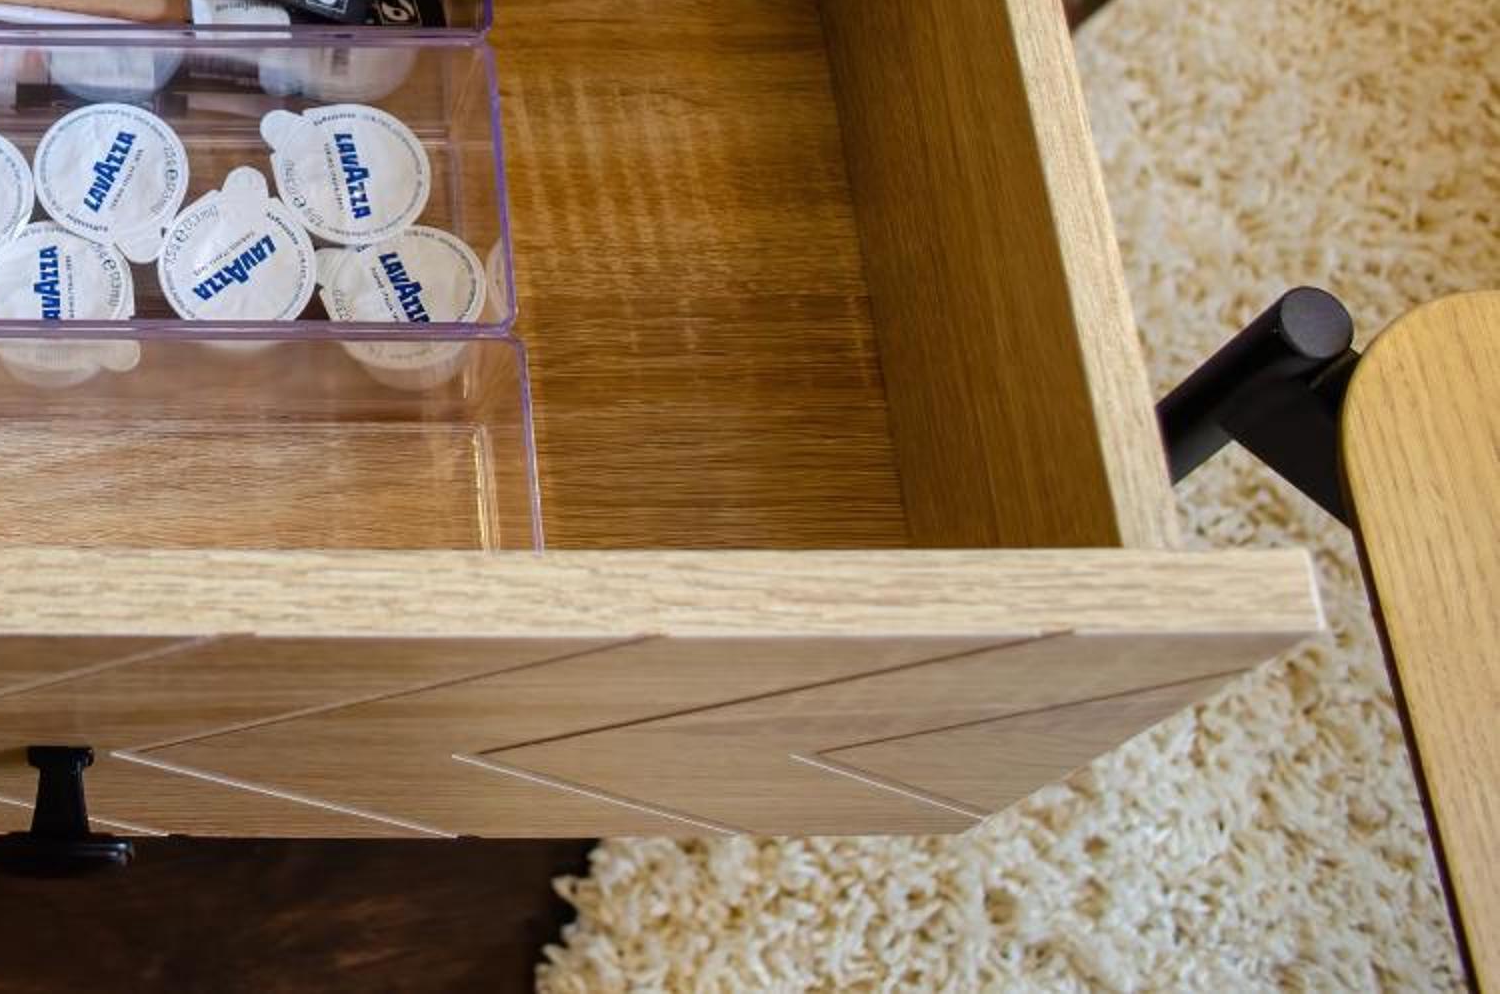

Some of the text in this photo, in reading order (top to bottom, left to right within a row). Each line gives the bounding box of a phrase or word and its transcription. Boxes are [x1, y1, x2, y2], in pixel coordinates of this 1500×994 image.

[84, 130, 137, 213] LAVAZZA
[333, 132, 372, 220] LAVAZZA
[33, 245, 61, 319] AVAZZA
[191, 235, 278, 302] LAVAZZA
